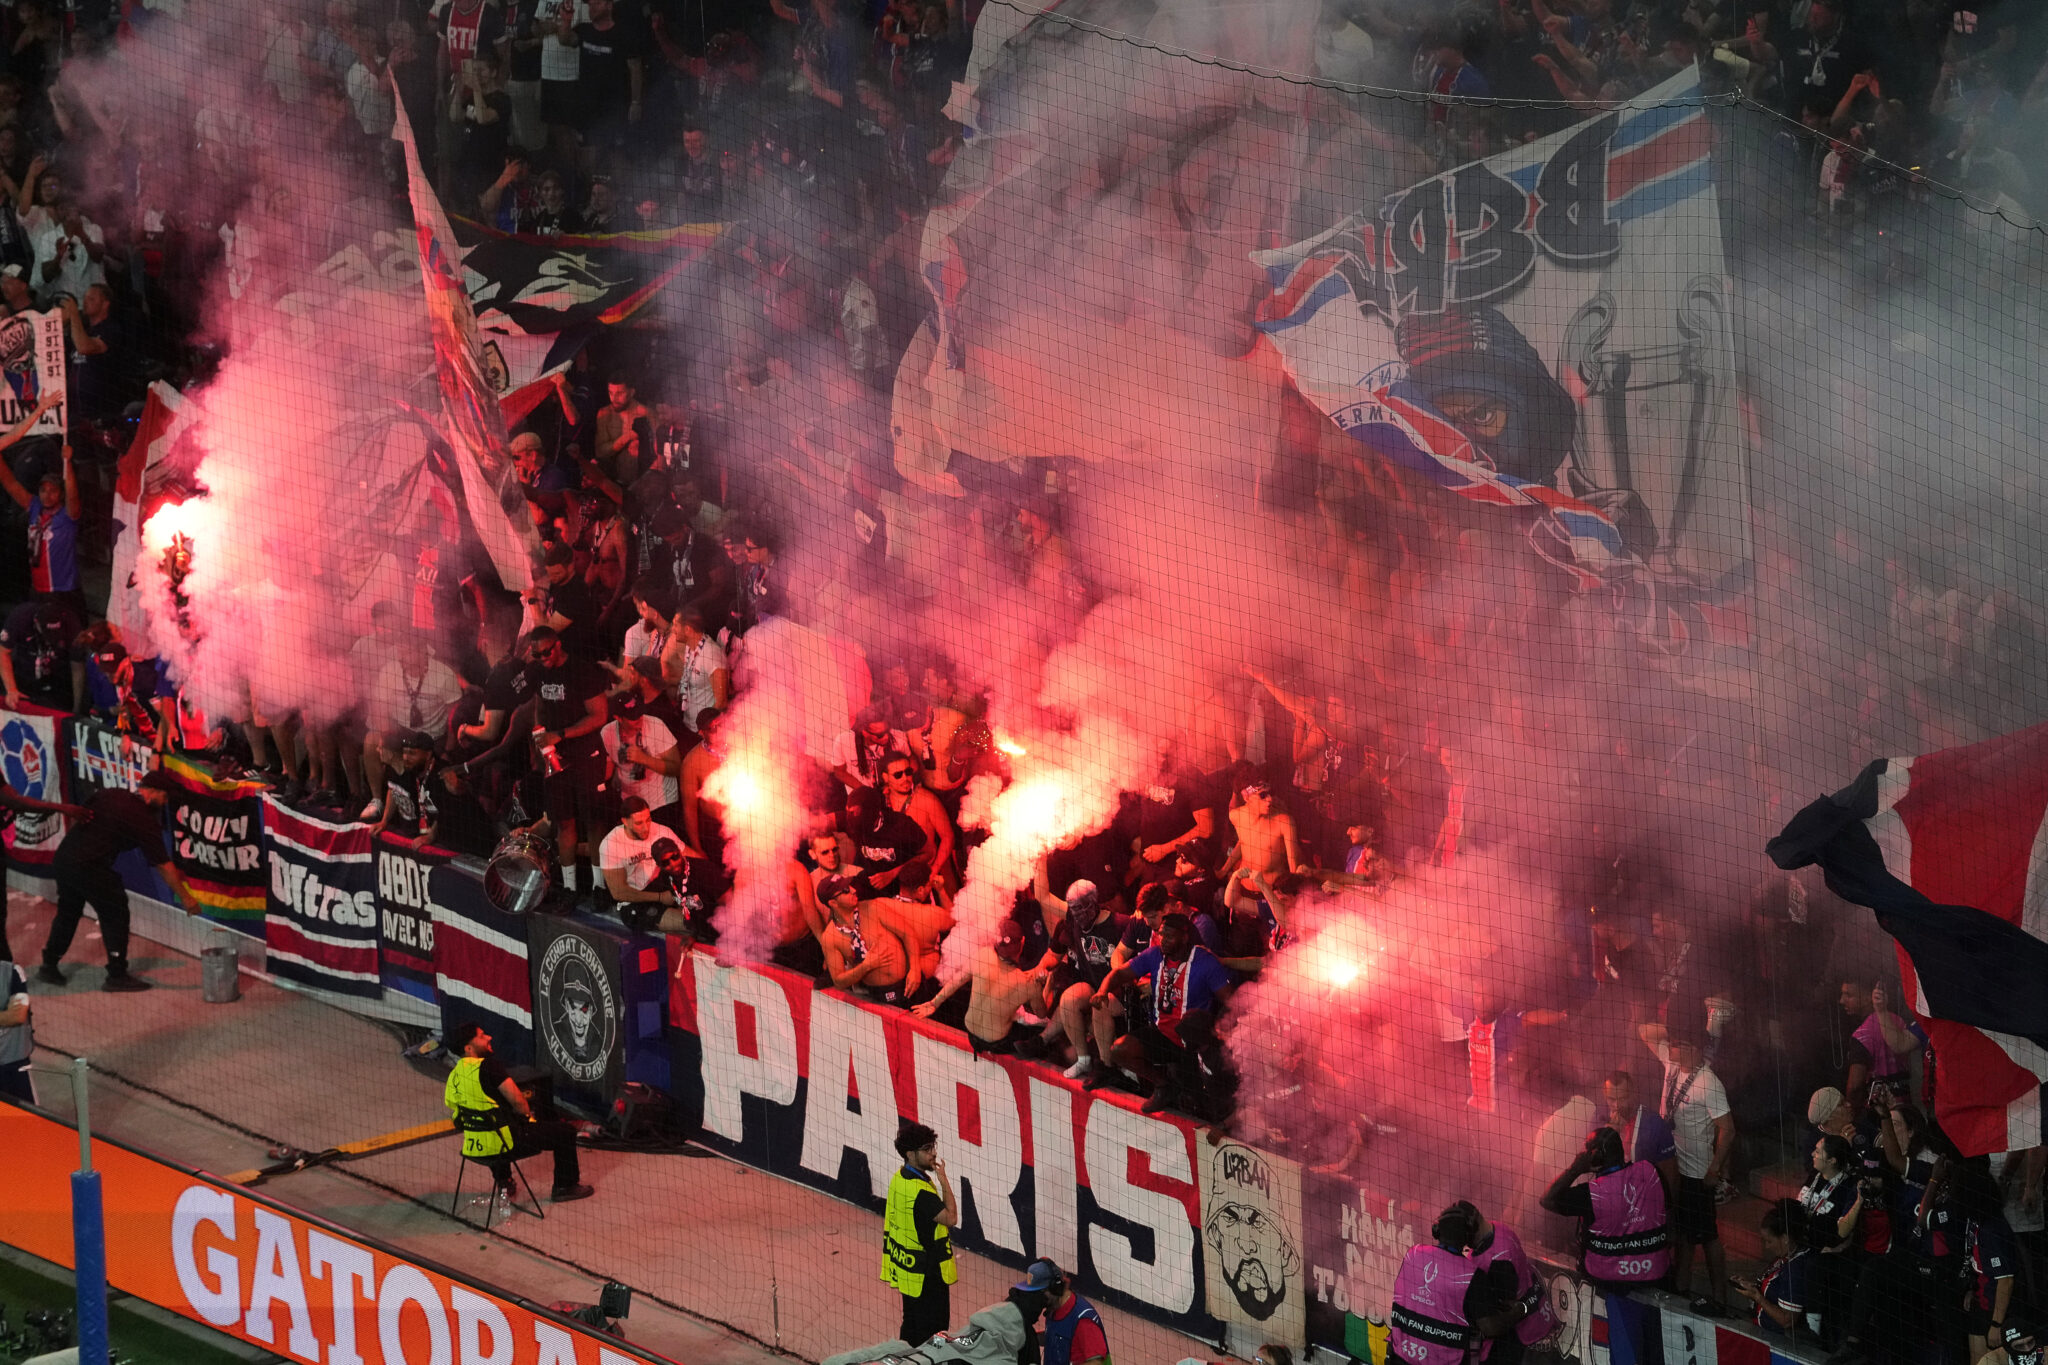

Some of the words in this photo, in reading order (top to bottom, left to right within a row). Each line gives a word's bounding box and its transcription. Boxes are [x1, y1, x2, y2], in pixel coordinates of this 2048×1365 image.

[448, 26, 477, 51] RTL
[382, 908, 416, 947] AVEC
[545, 938, 577, 971] COMBAT
[550, 1035, 582, 1079] ULTRAS
[693, 950, 1195, 1314] PARIS
[1223, 1151, 1270, 1200] URBAN
[171, 1185, 650, 1365] GATOR
[1618, 1259, 1652, 1275] 309
[1408, 1319, 1423, 1331] FAN
[1424, 1325, 1463, 1340] SUPPORT
